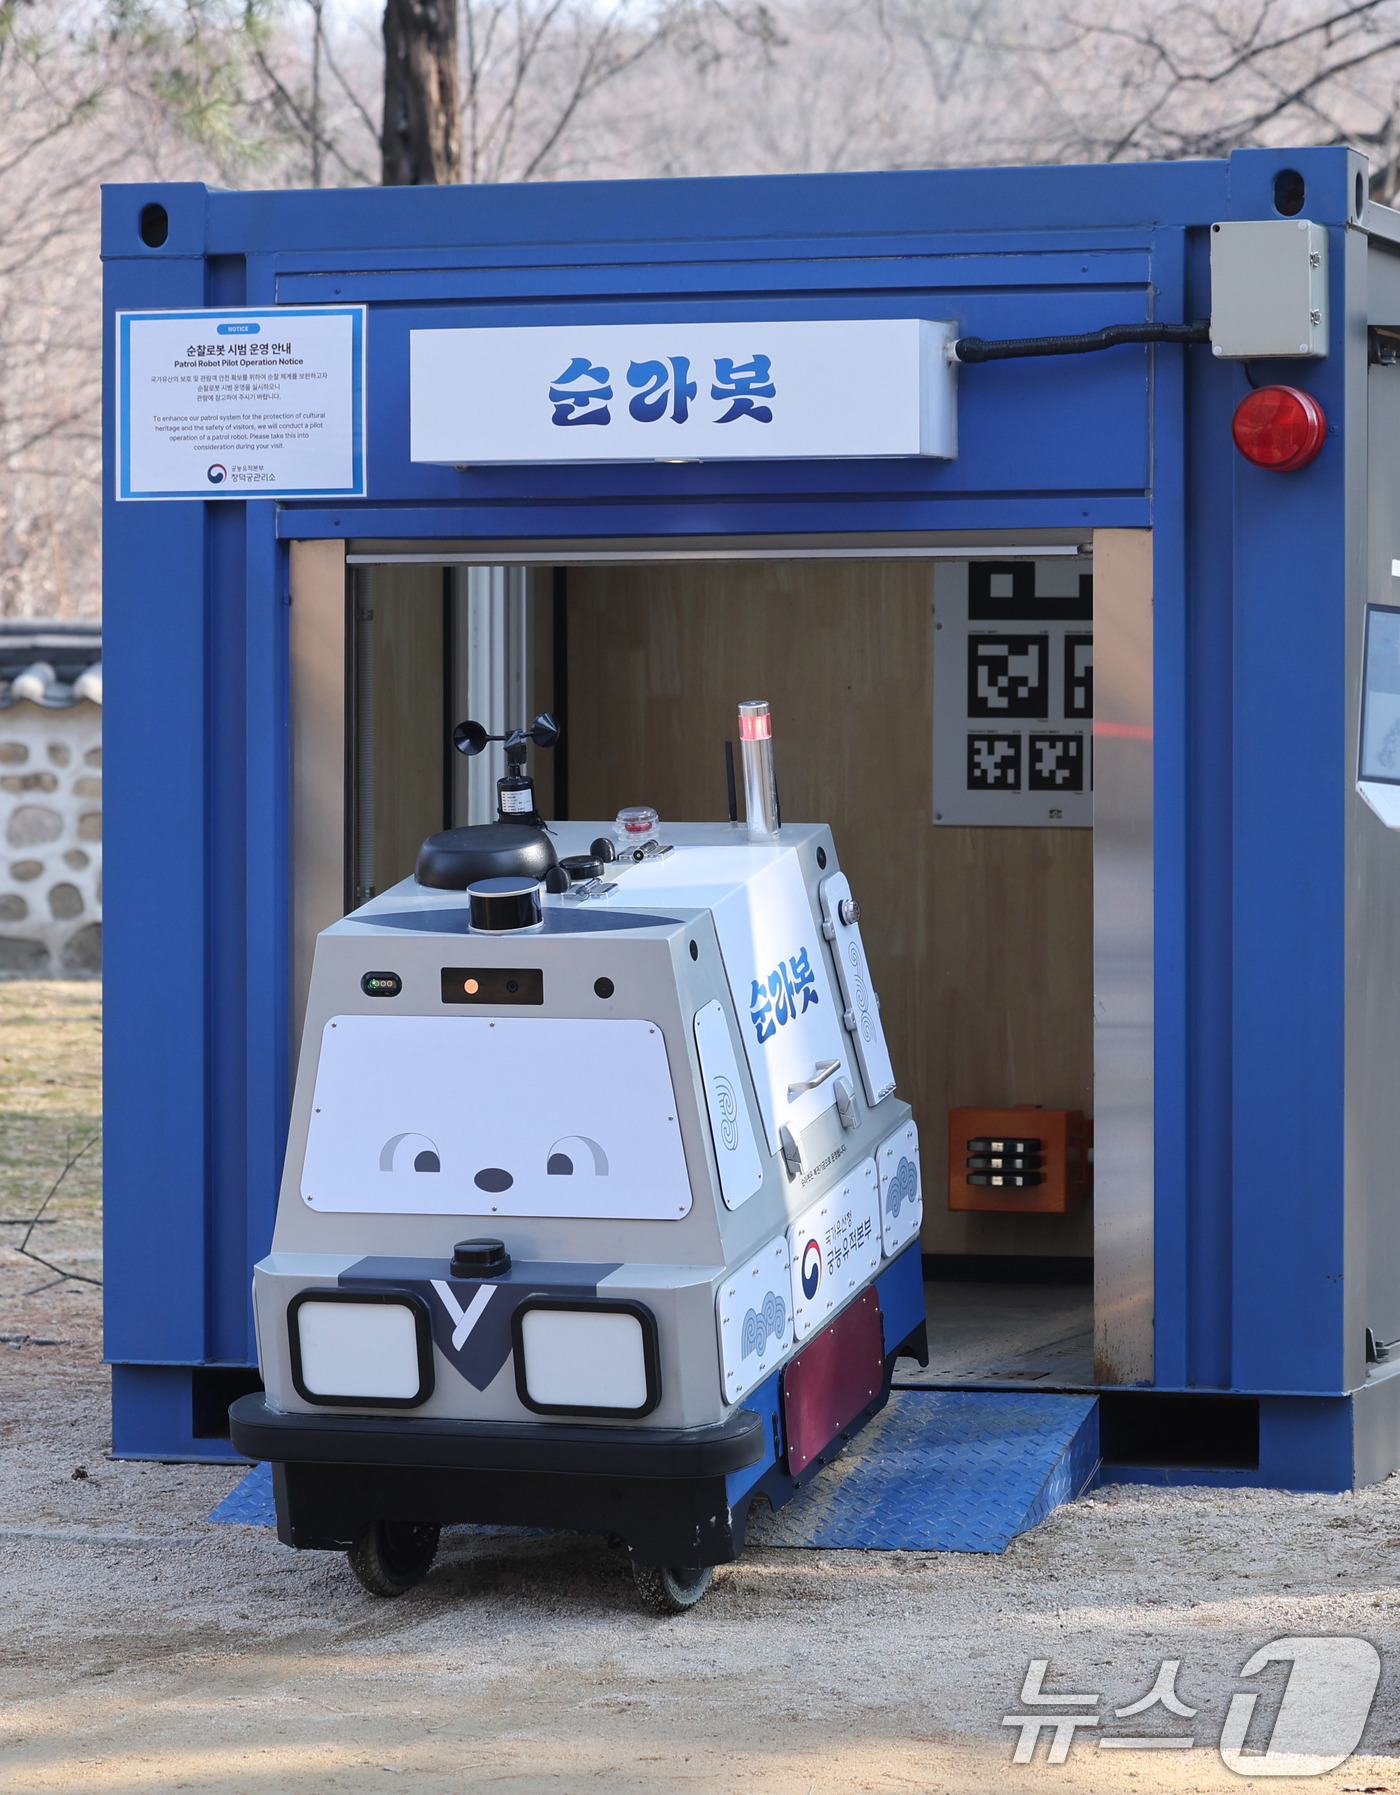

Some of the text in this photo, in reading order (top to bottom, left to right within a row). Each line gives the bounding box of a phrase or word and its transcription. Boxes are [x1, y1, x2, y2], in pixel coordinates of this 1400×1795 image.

[186, 343, 292, 357] 순찰로봇 시범 운영 안내
[240, 359, 277, 367] Operation
[268, 373, 279, 381] 순찰
[548, 354, 777, 427] 순라봇
[215, 394, 237, 402] 참고하여
[201, 414, 218, 422] patrol
[263, 413, 294, 421] protection
[155, 425, 180, 433] heritage
[205, 424, 224, 432] safety
[233, 423, 256, 431] visitors,
[310, 422, 323, 430] pilot
[212, 433, 229, 441] patrol
[194, 443, 234, 451] consideration
[236, 443, 255, 451] during
[256, 443, 269, 451] your
[231, 473, 276, 482] 창덕궁관리소
[750, 946, 819, 1044] 순라봇
[825, 1209, 853, 1246] 국가유산청
[826, 1215, 873, 1276] 궁능유적본부
